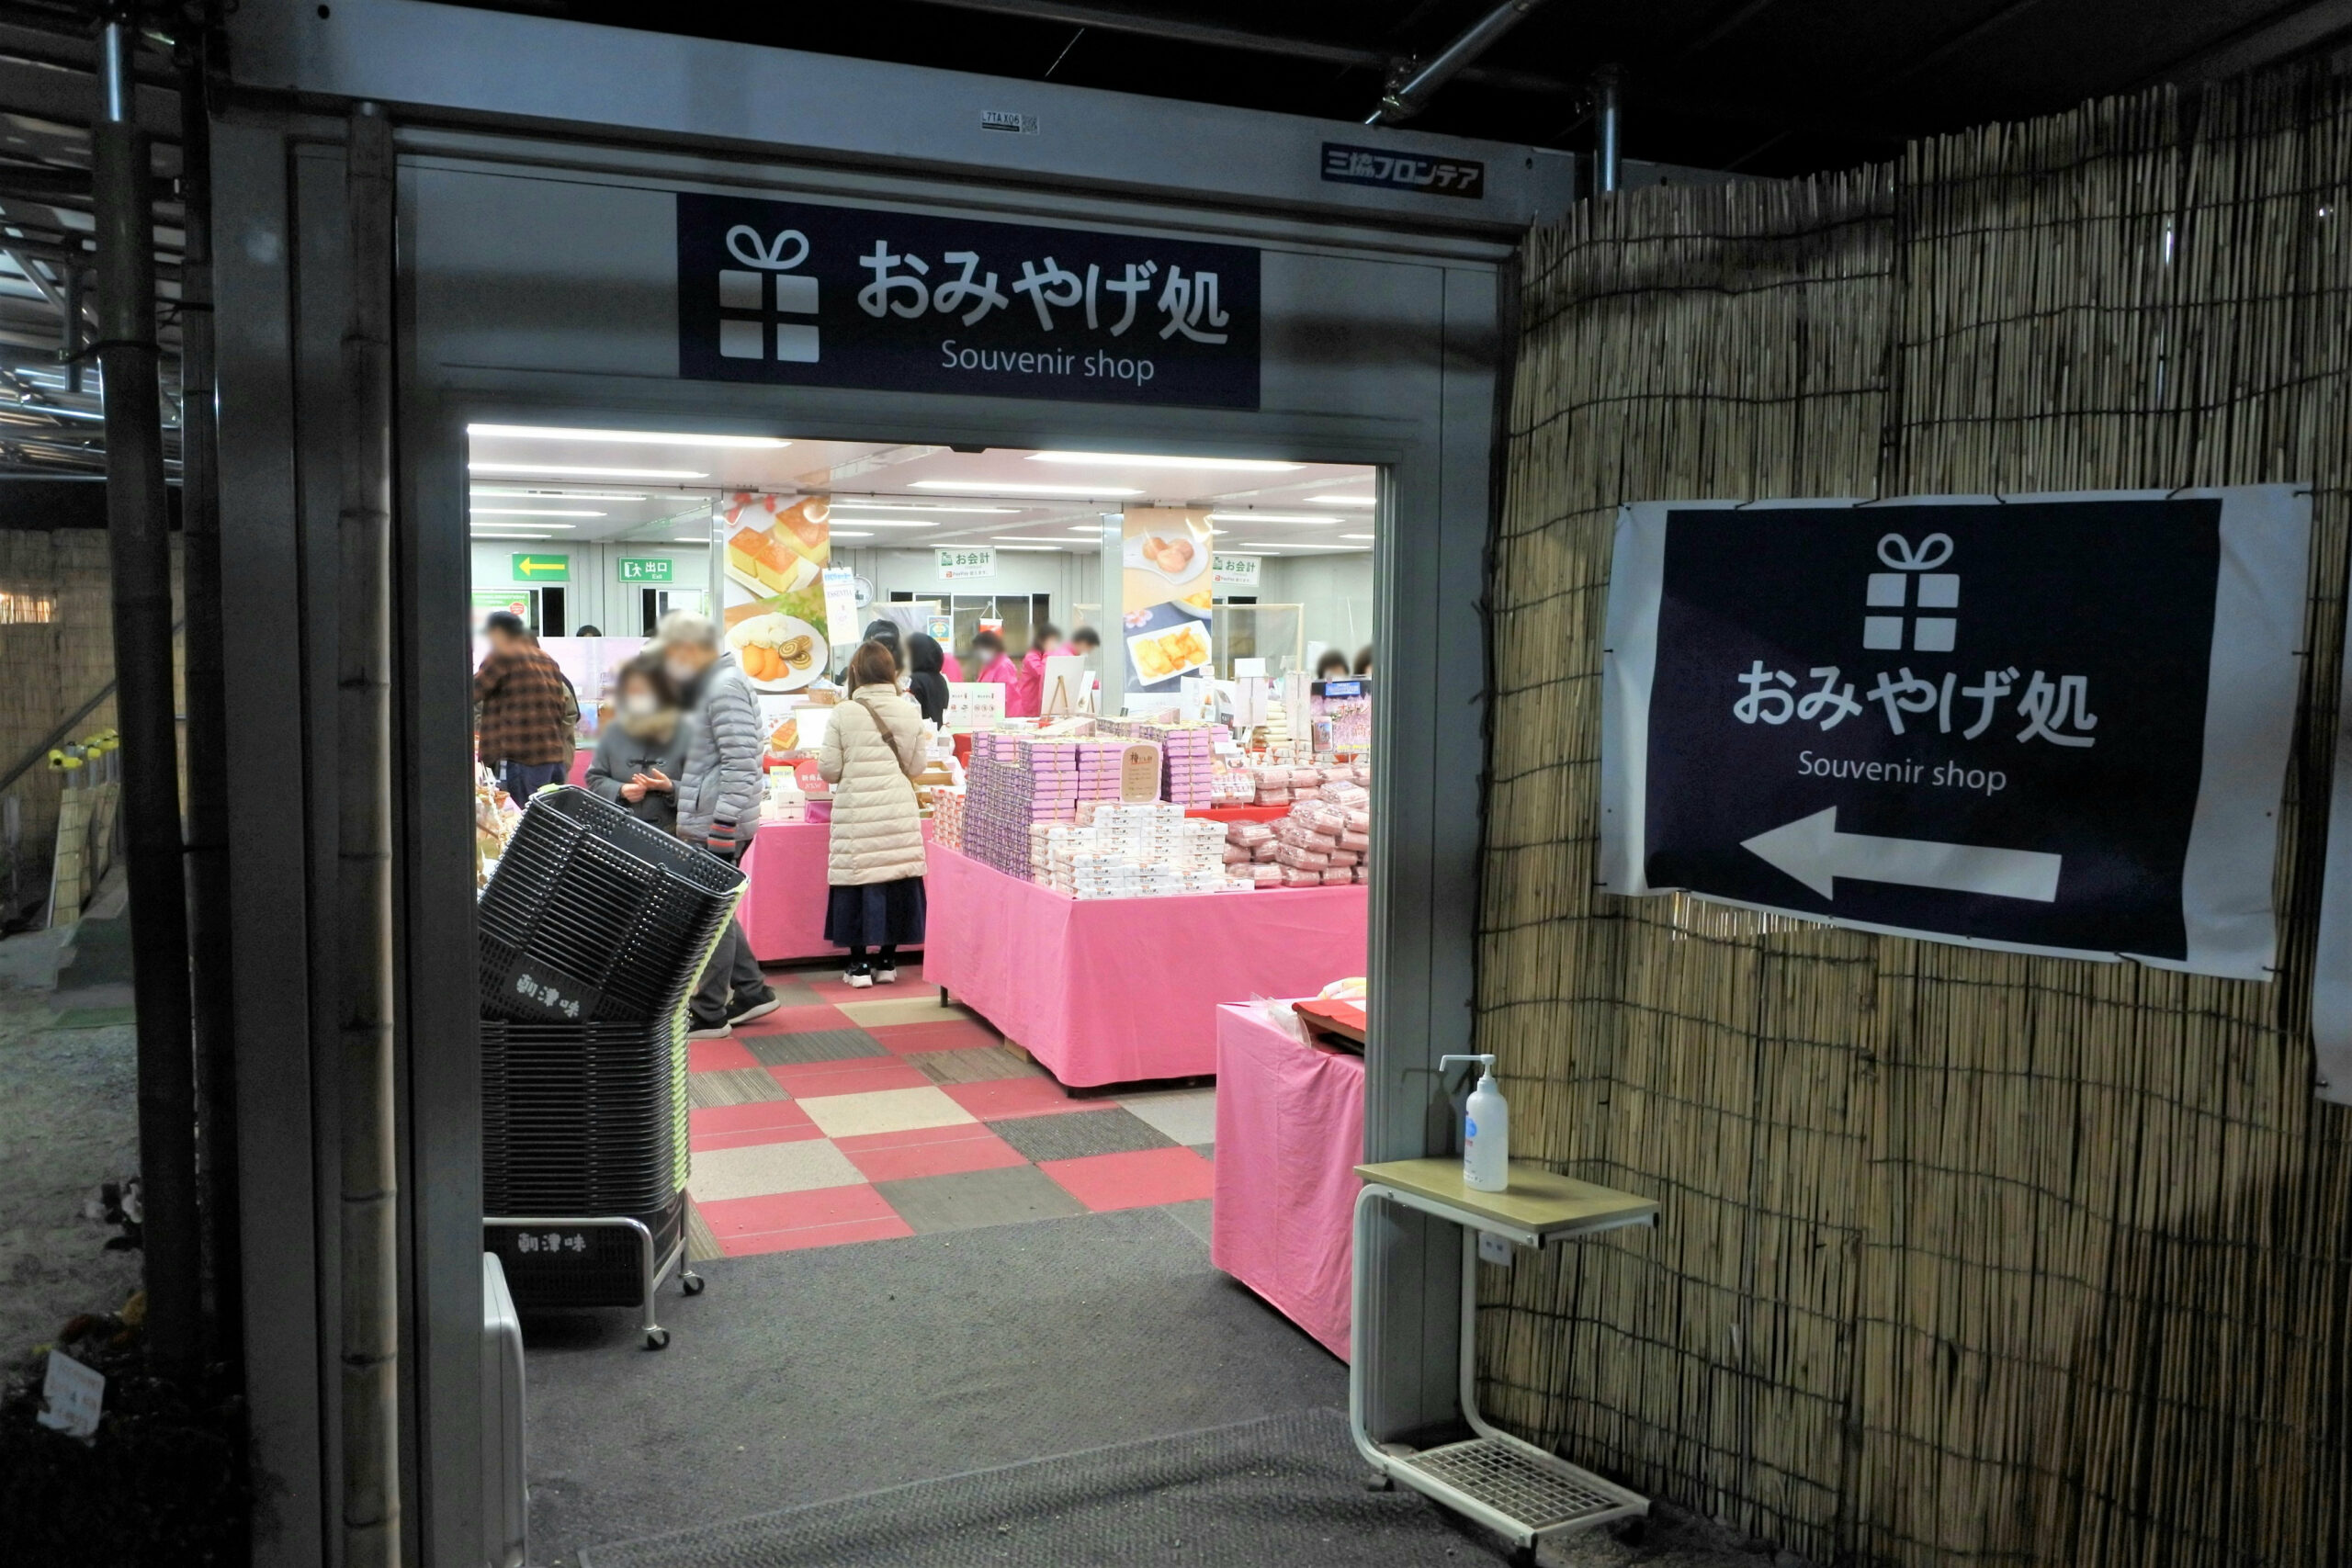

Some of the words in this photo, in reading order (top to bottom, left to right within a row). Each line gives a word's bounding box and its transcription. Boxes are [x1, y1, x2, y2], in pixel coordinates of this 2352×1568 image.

[1325, 150, 1479, 189] 三協フロンテア
[857, 239, 1230, 344] おみやげ処
[942, 339, 1075, 376] Souvenir
[1084, 349, 1155, 387] shop
[645, 561, 667, 572] 出口
[956, 552, 989, 565] お会計
[1226, 559, 1255, 572] お会計
[1733, 660, 2098, 748] おみやげ処
[1797, 750, 1925, 784] Souvenir
[1931, 760, 2007, 796] shop
